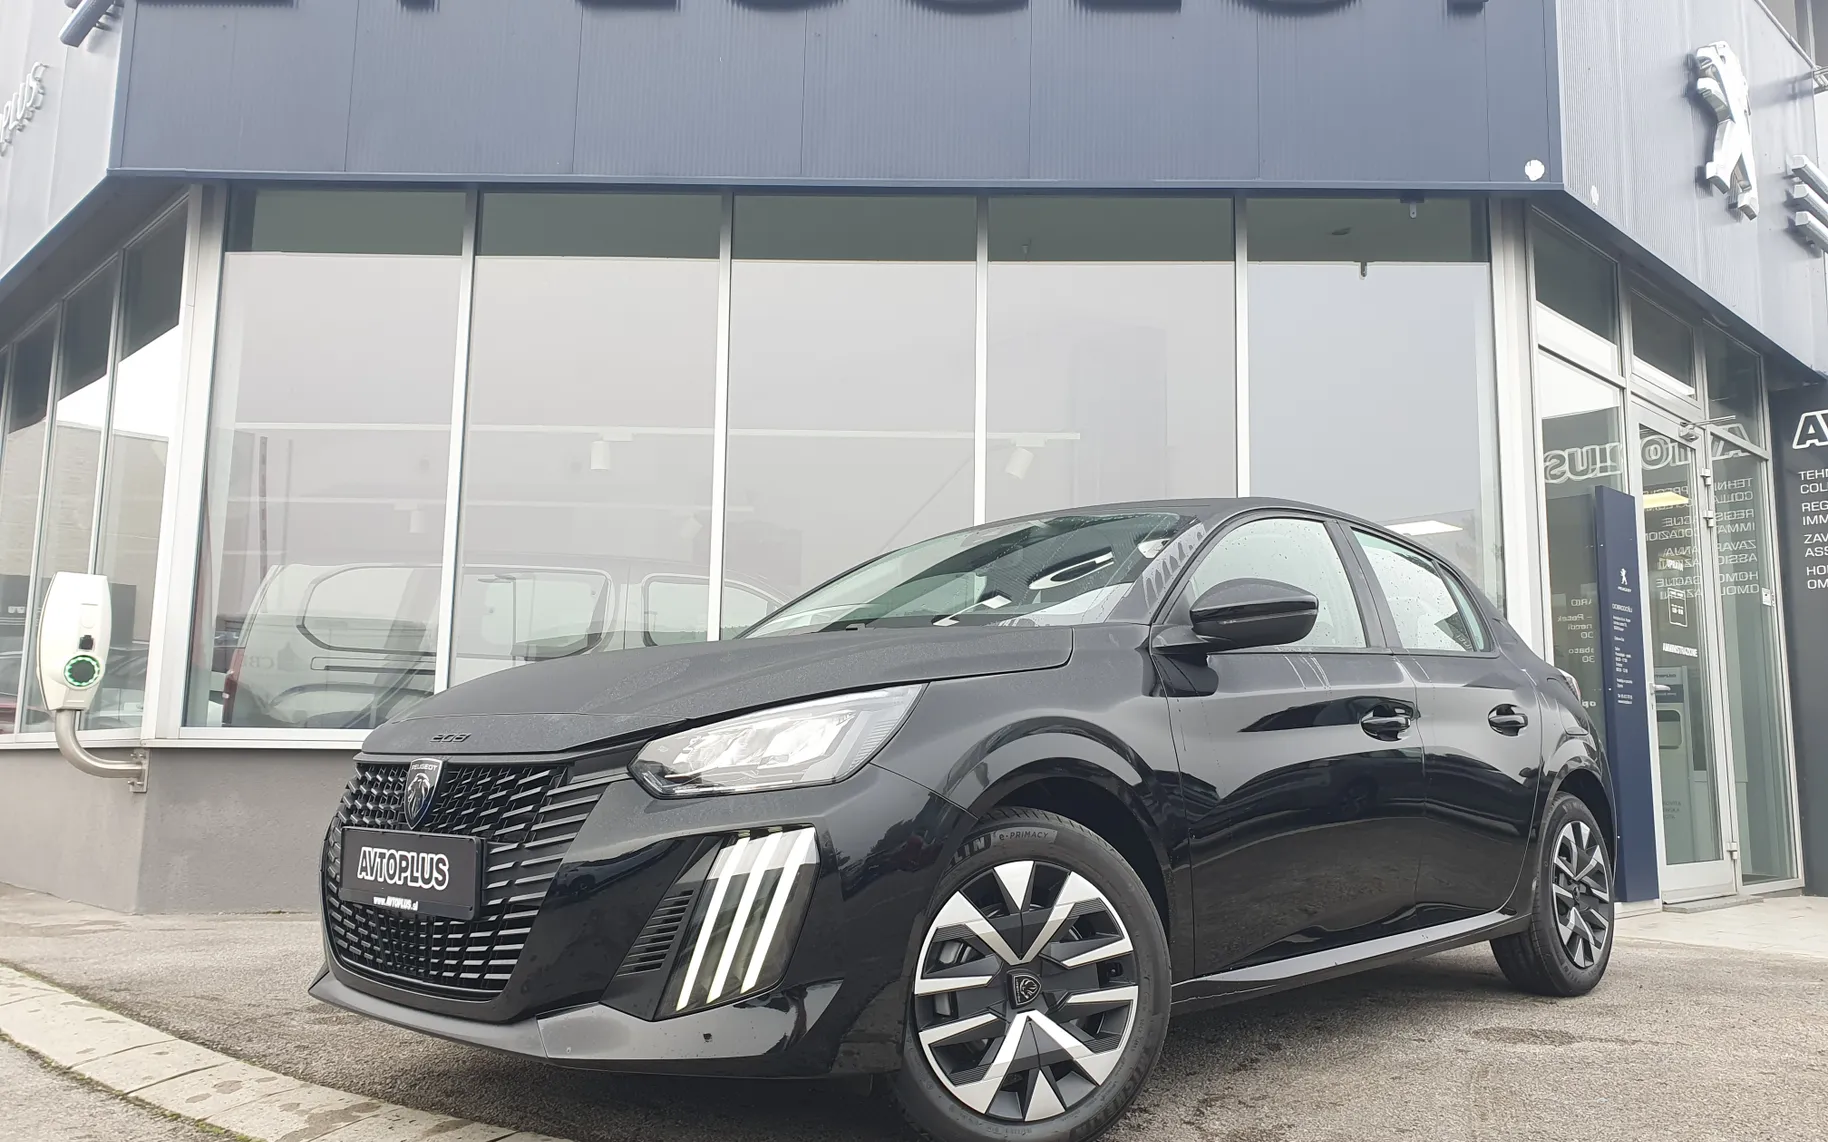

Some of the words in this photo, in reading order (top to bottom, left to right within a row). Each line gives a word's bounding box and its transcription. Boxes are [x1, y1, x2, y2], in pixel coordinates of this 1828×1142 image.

[430, 732, 472, 743] 208
[411, 763, 438, 771] PEUGEOT
[999, 830, 1048, 841] e-PRIMACY
[357, 846, 450, 891] AVTOPLUS
